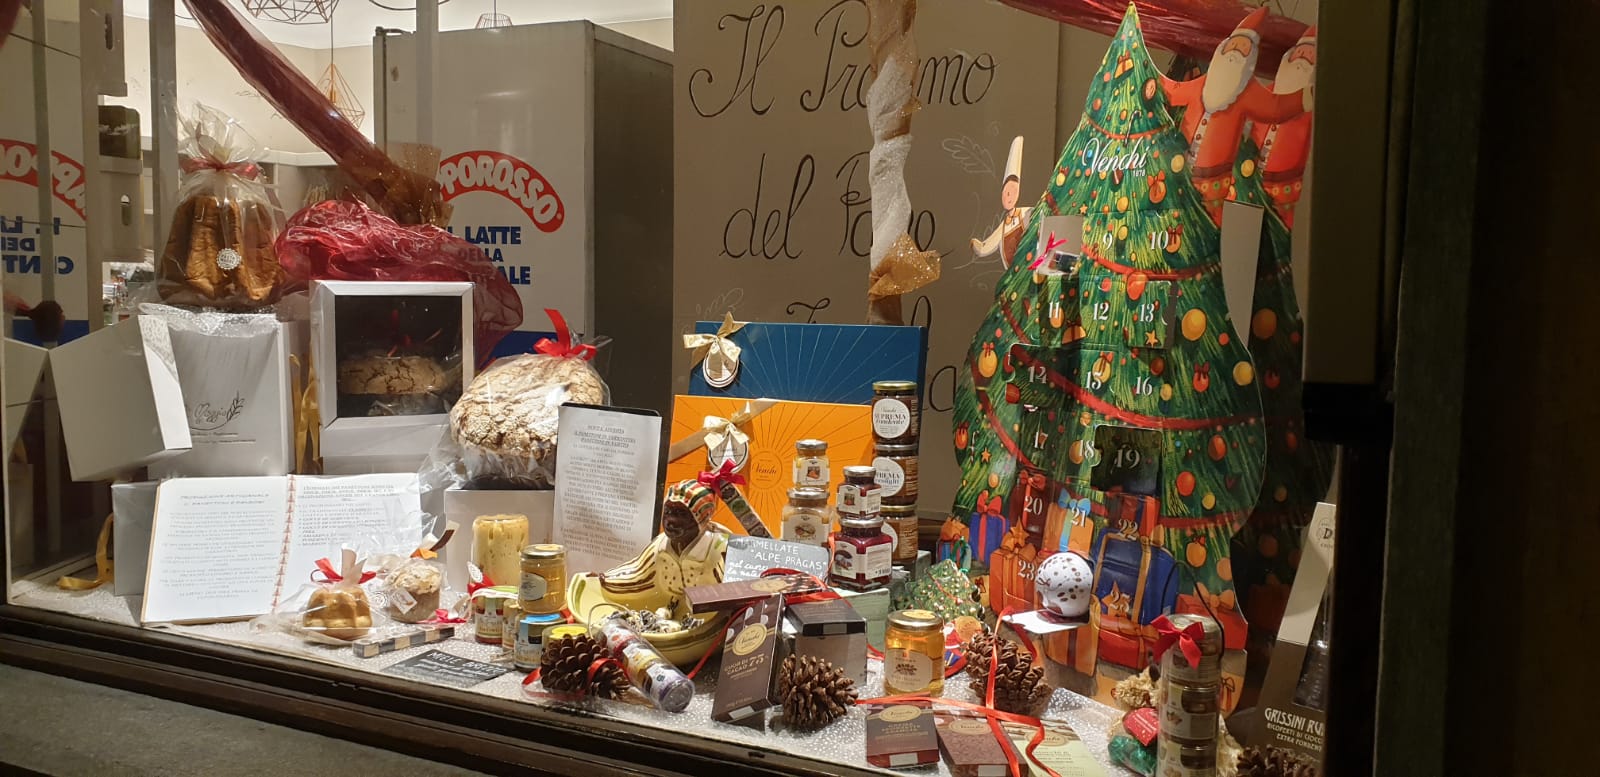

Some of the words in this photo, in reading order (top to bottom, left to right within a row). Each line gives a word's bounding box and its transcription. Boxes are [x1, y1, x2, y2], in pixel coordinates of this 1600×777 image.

[689, 4, 784, 117] Il
[800, 0, 999, 112] Promo
[1082, 136, 1149, 174] Venchi
[719, 153, 803, 259] del
[465, 226, 521, 244] LATTE
[1103, 233, 1113, 250] 9
[1150, 231, 1169, 250] 10
[1048, 301, 1060, 319] 11
[1093, 302, 1110, 320] 12
[1139, 304, 1155, 322] 13
[1028, 366, 1049, 384] 14
[1085, 371, 1101, 389] 15
[1136, 376, 1153, 395] 16
[1034, 432, 1048, 449] 17
[1079, 440, 1095, 458] 18
[1114, 445, 1141, 469] 19
[1024, 495, 1043, 515] 20
[1071, 507, 1087, 527] 21
[1118, 518, 1139, 541] 22
[1018, 560, 1036, 581] 23
[1109, 591, 1130, 612] 25
[1265, 708, 1306, 731] GRISSINI
